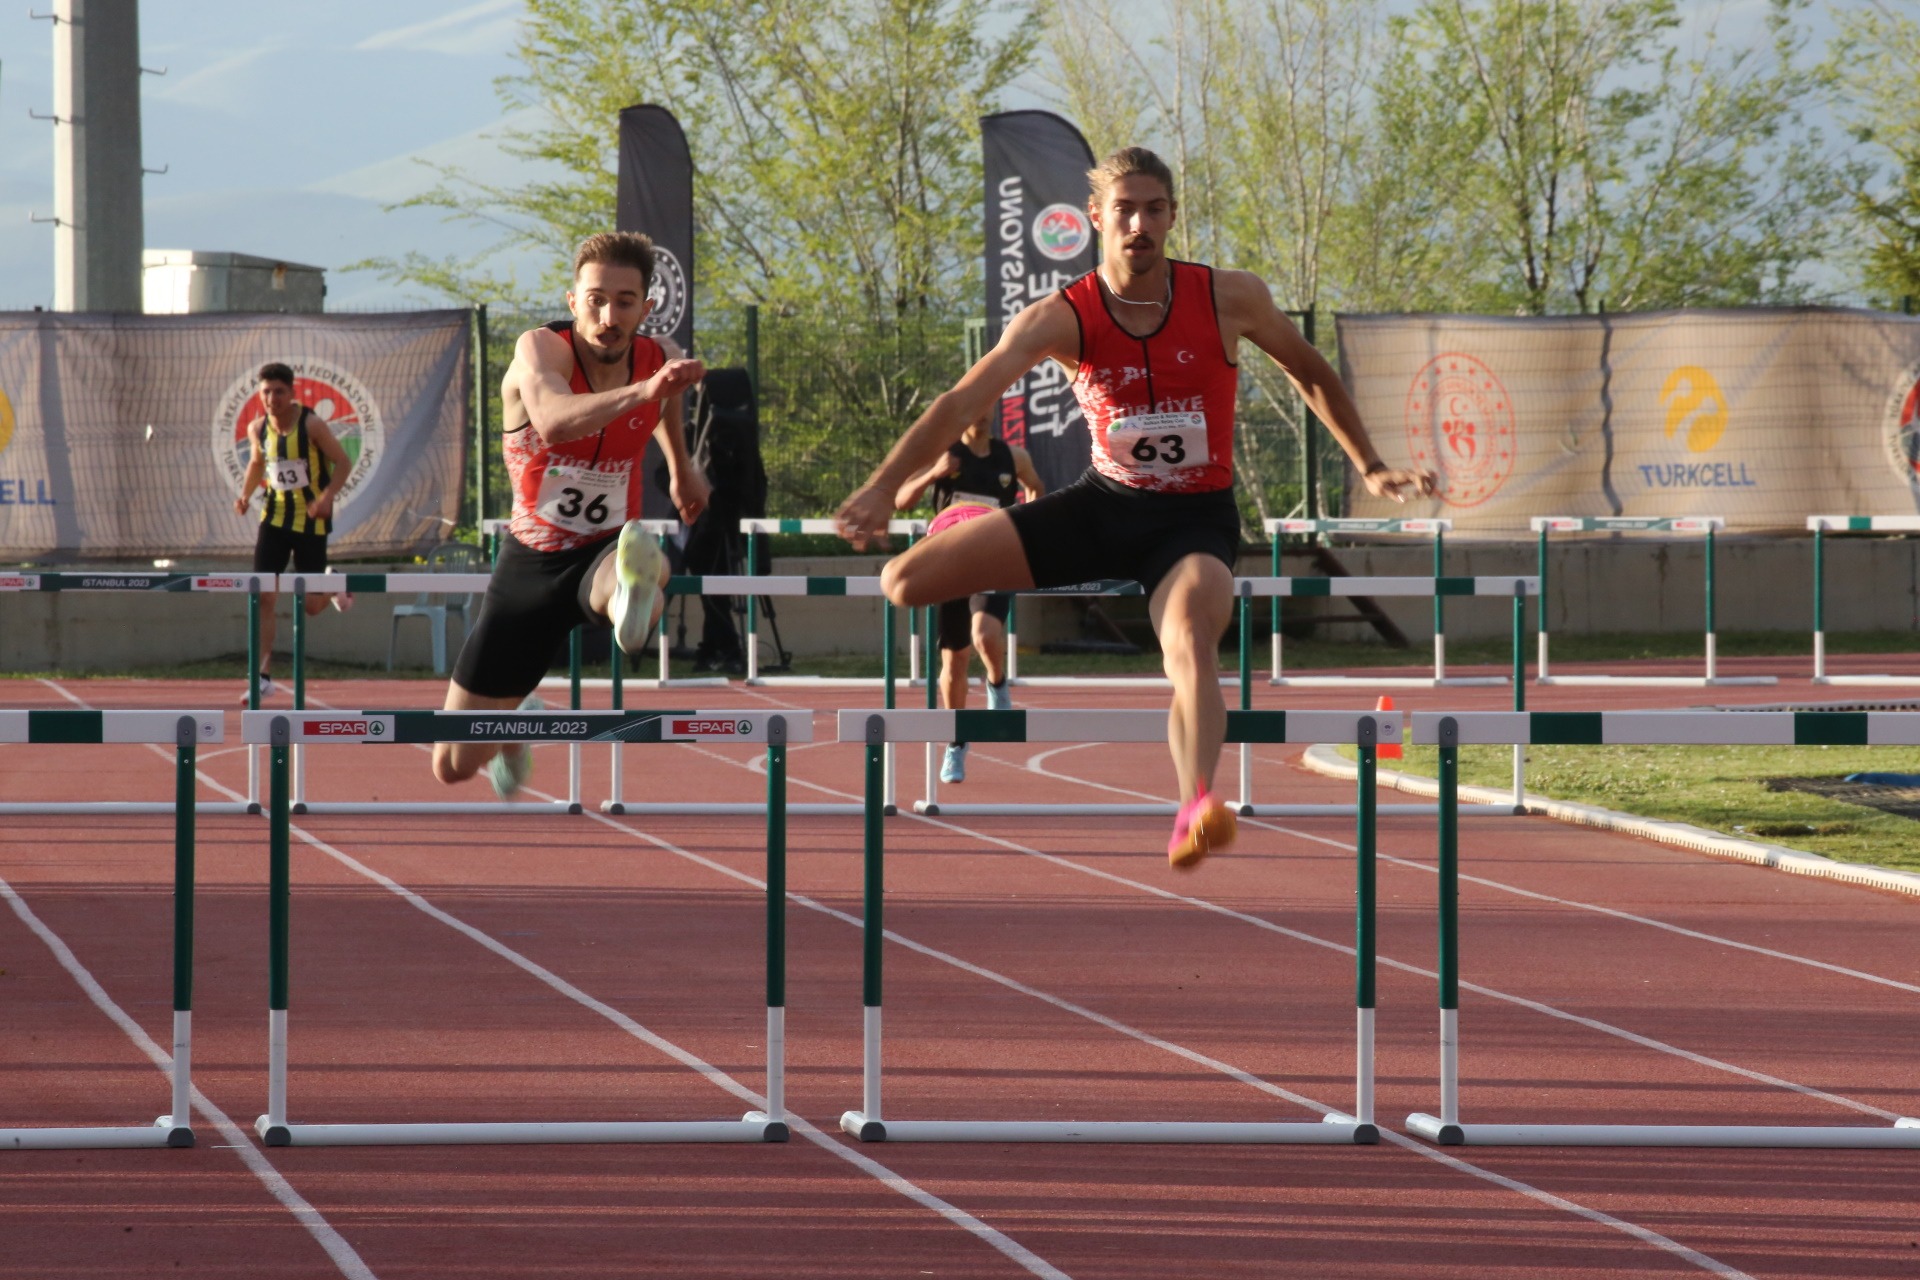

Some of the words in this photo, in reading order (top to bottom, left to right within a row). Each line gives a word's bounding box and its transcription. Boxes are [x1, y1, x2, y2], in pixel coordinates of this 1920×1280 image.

[1131, 434, 1186, 464] 63
[277, 470, 298, 485] 43
[1638, 462, 1756, 488] TURKCELL
[557, 487, 609, 525] 36
[82, 578, 127, 587] ISTANBUL
[128, 578, 150, 587] 2023
[205, 578, 234, 588] SPAR
[319, 723, 366, 734] SPAR
[470, 721, 547, 735] ISTANBUL
[550, 721, 588, 735] 2023
[687, 722, 734, 733] SPAR
